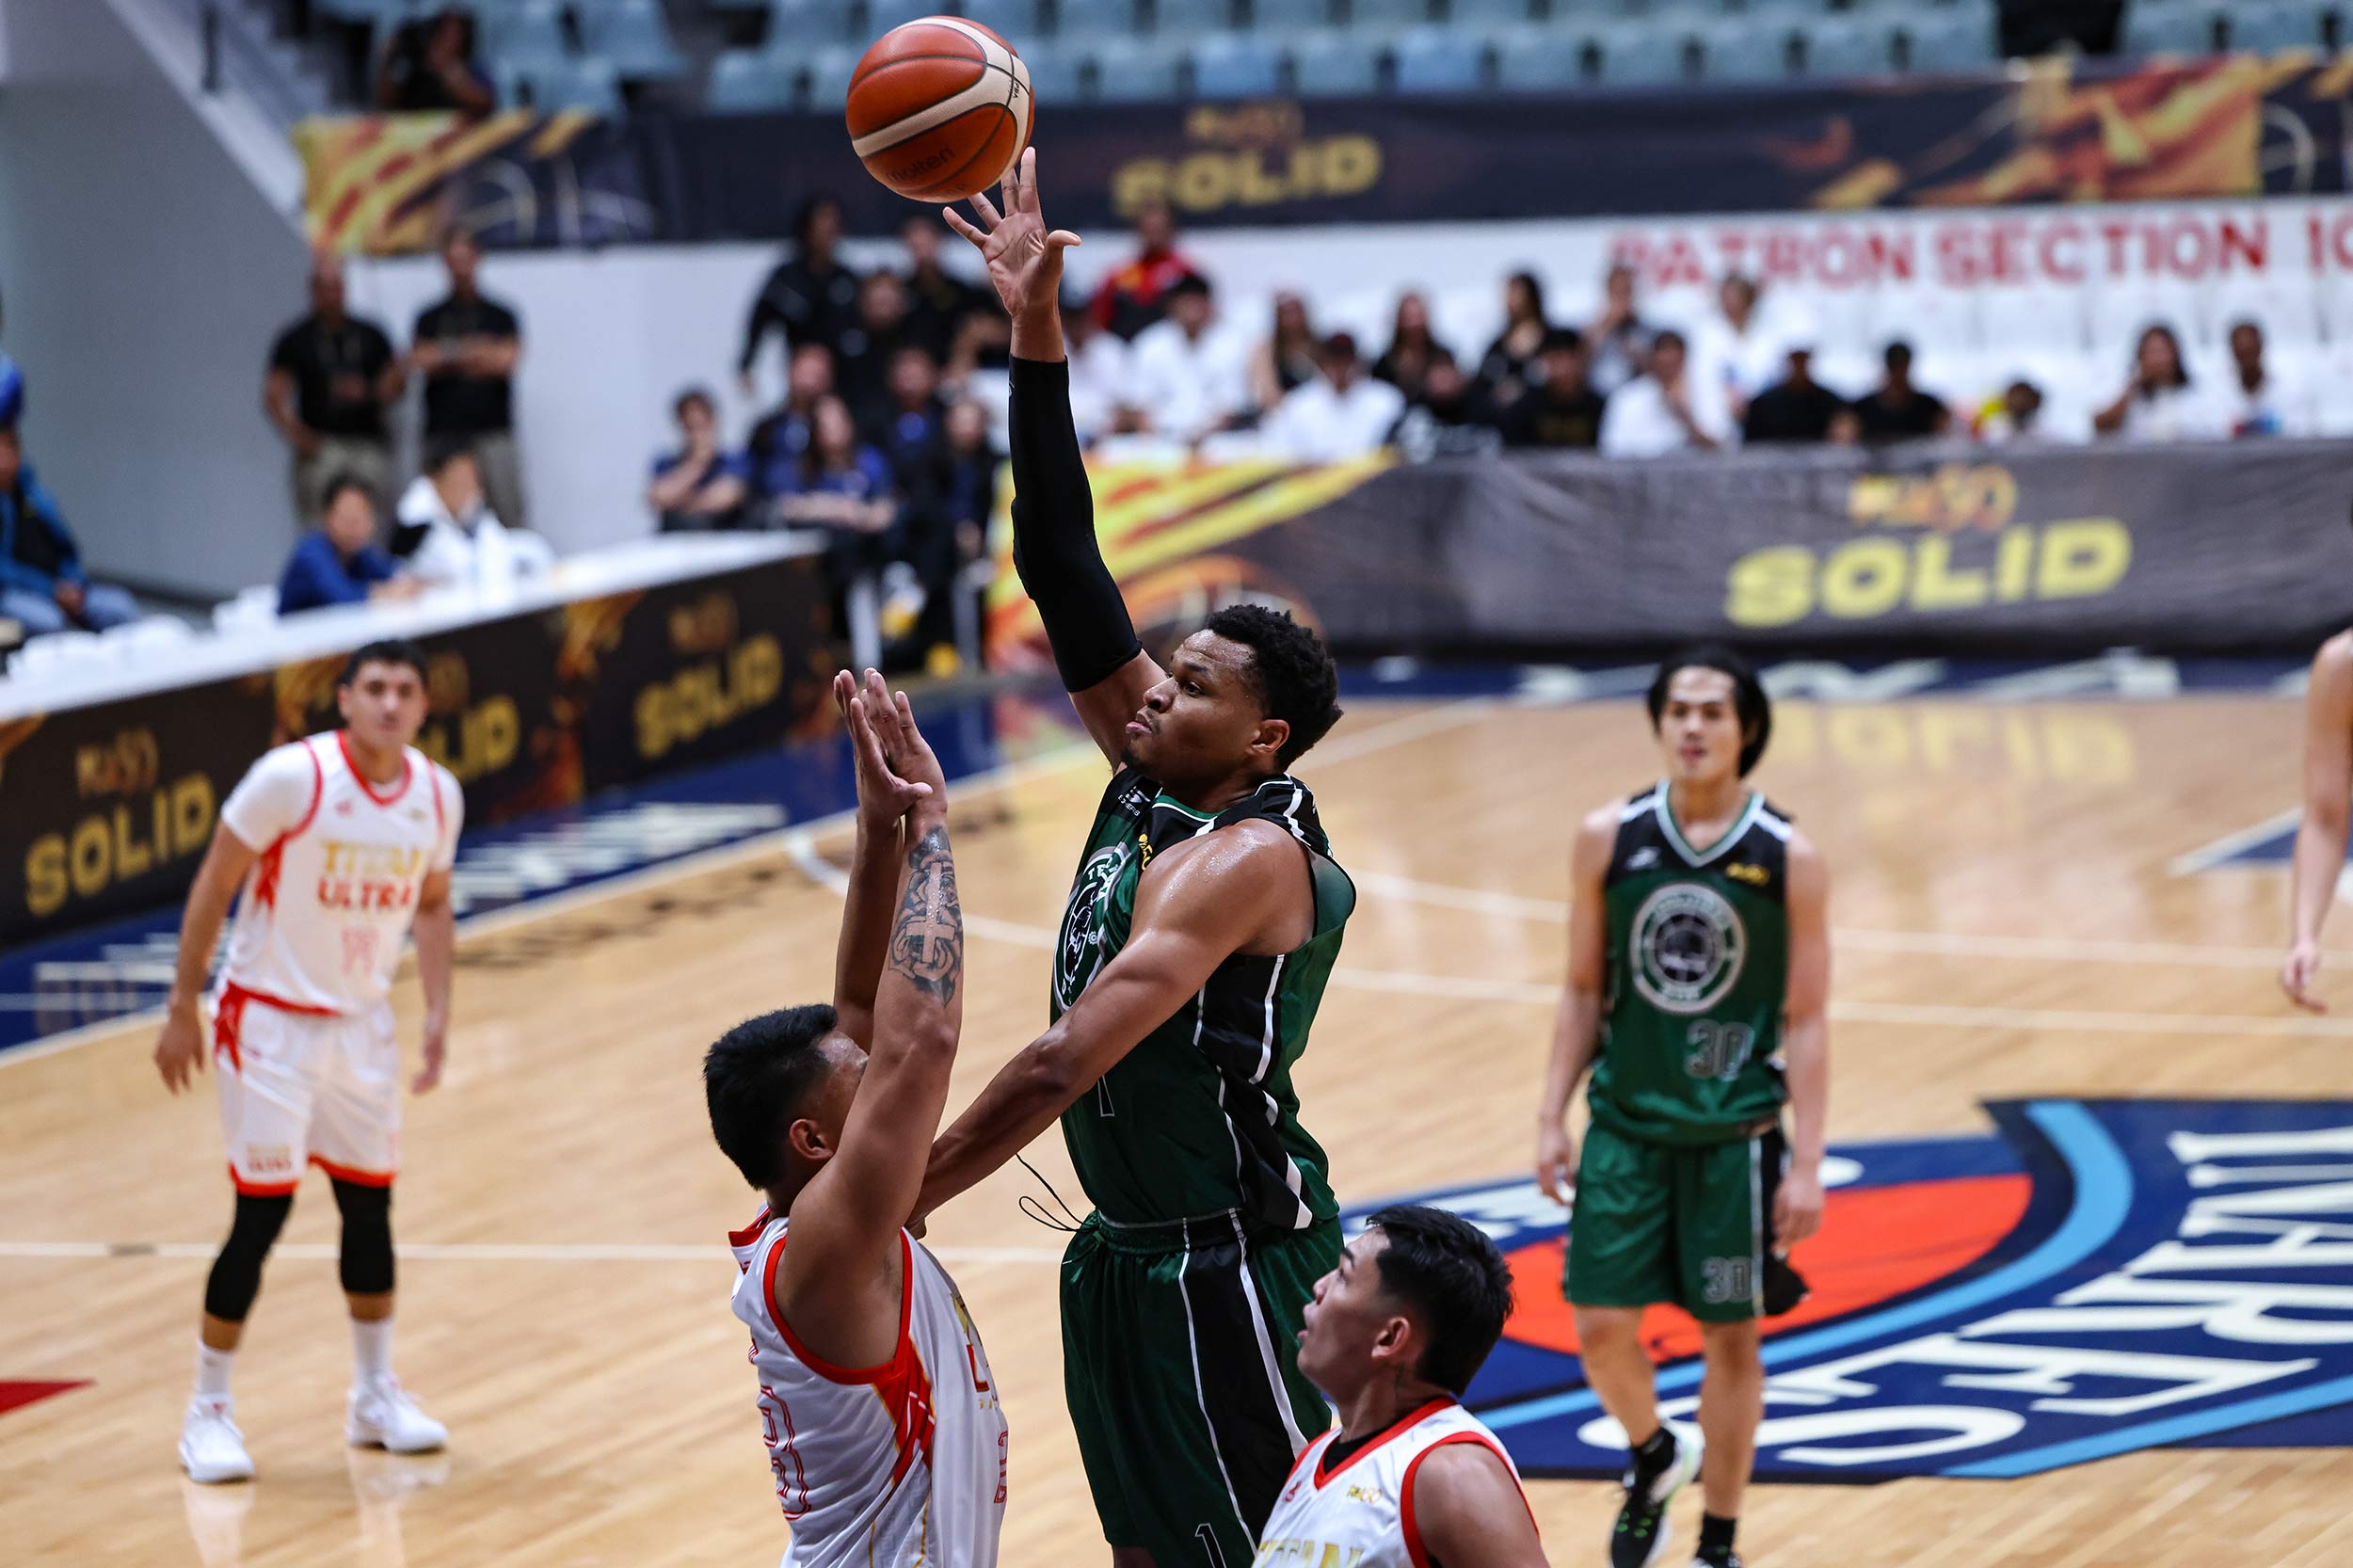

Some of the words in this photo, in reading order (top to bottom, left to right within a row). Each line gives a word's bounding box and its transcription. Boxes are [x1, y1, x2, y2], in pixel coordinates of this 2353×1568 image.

[885, 146, 955, 183] molten
[1606, 226, 1914, 288] PATRON
[1934, 215, 2267, 288] SECTION
[1724, 517, 2133, 629] SOLID
[635, 633, 783, 759] SOLID
[24, 772, 216, 919] SOLID
[1685, 1019, 1755, 1082] 30
[1701, 1256, 1753, 1304] 30
